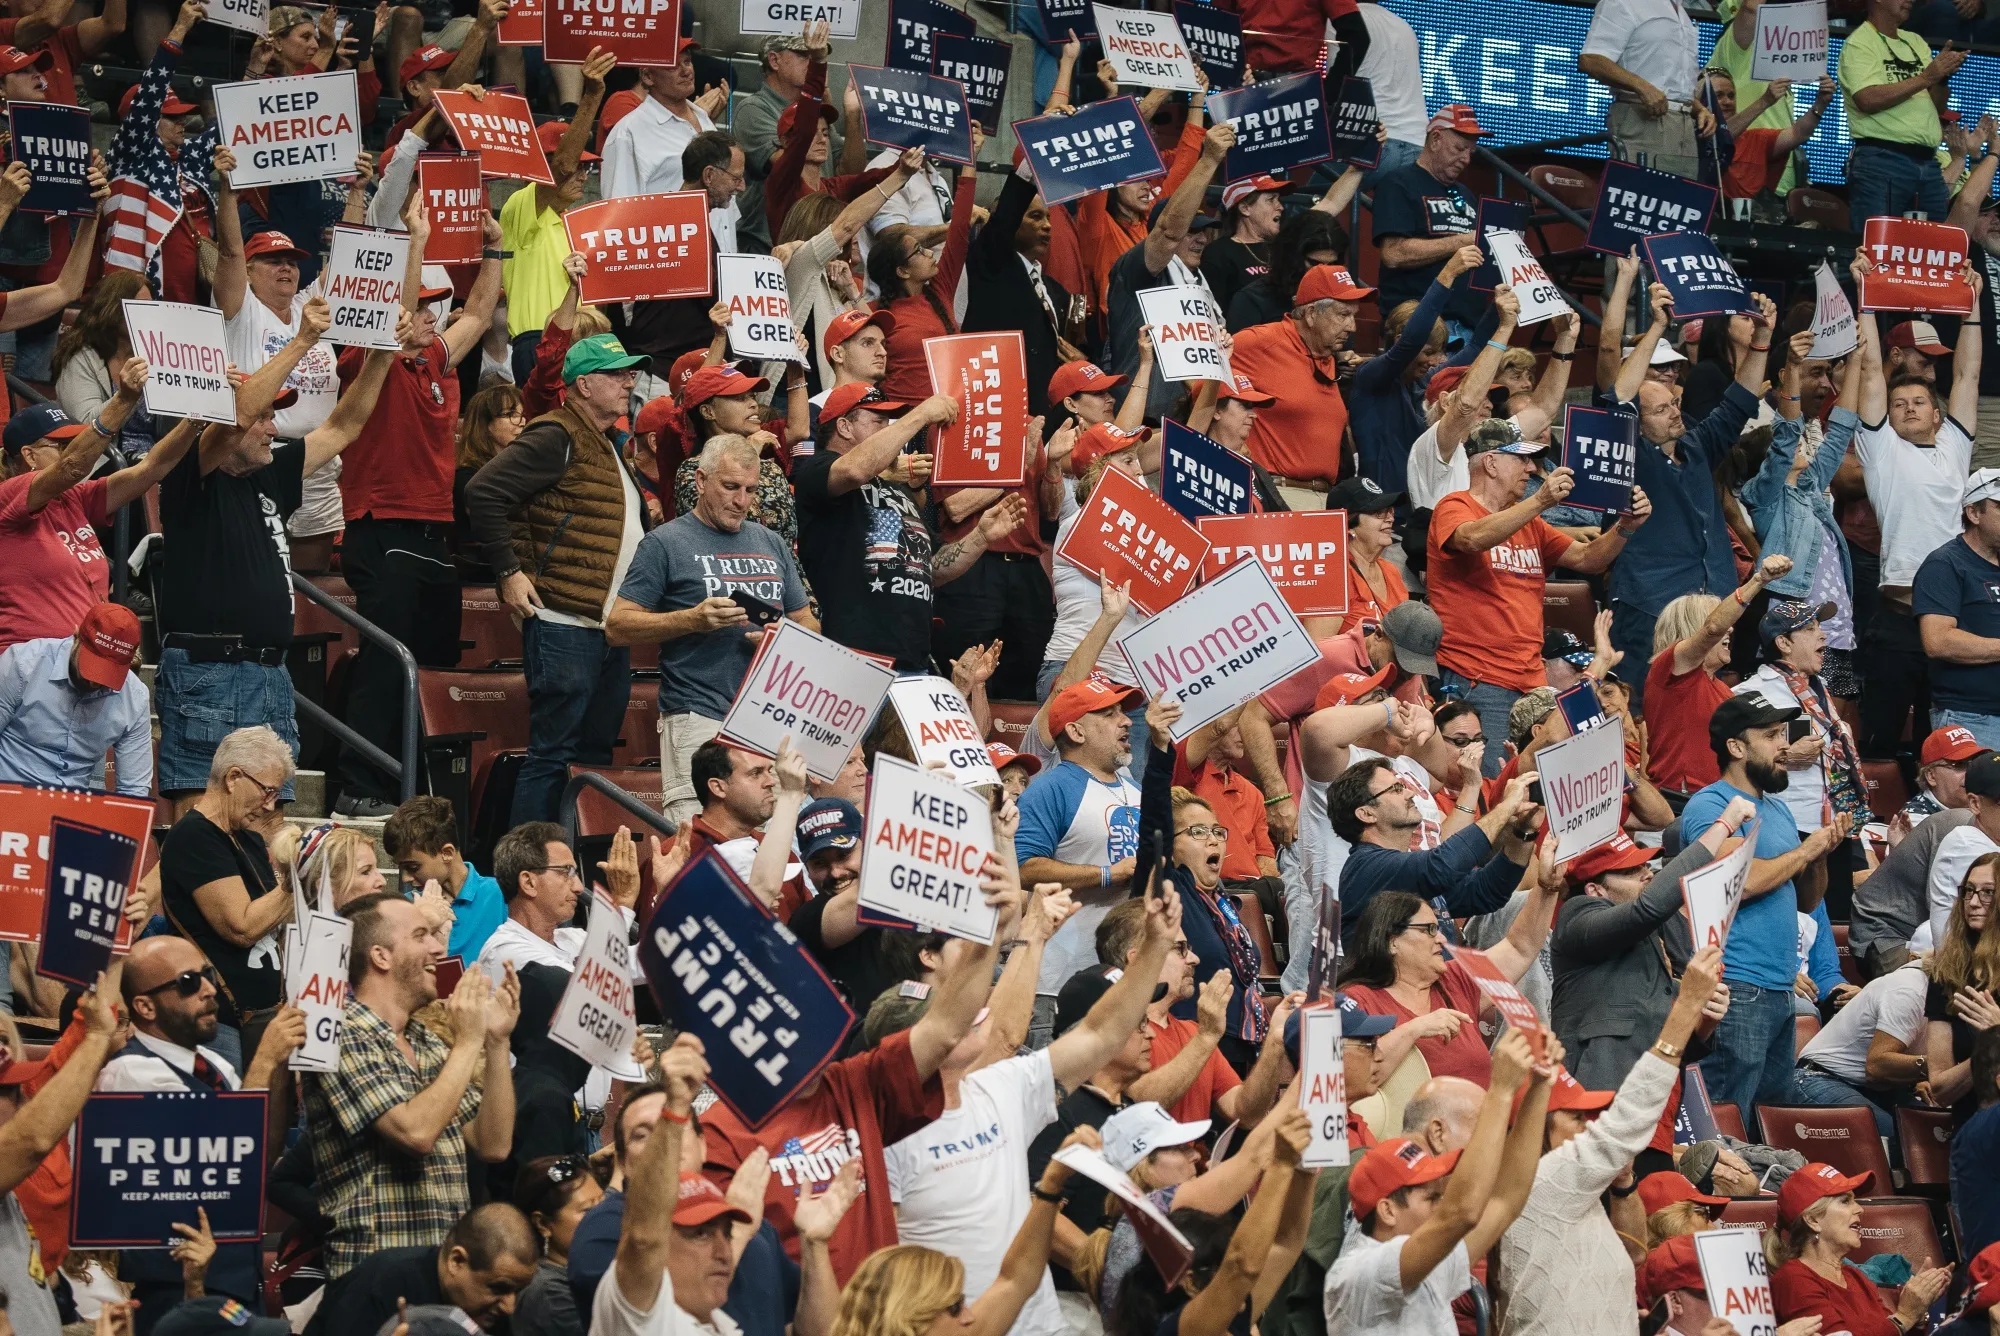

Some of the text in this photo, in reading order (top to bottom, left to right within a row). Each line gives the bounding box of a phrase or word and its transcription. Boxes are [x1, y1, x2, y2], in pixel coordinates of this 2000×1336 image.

[563, 15, 657, 30] PENCE
[767, 3, 842, 24] GREAT!
[588, 30, 620, 38] AMERICA
[622, 31, 648, 39] GREAT!
[1116, 19, 1156, 36] KEEP
[1182, 24, 1240, 49] TRUMP
[1108, 35, 1187, 60] AMERICA
[1190, 42, 1238, 61] PENCE
[1771, 53, 1799, 64] FOR
[940, 60, 1005, 86] TRUMP
[1126, 59, 1182, 78] GREAT!
[259, 91, 320, 115] KEEP
[864, 86, 961, 115] TRUMP
[963, 83, 999, 99] ENCE
[453, 112, 530, 136] TRUMP
[878, 102, 956, 128] PENCE
[888, 116, 950, 135] KEEP AMERICA GREAT!
[1226, 98, 1320, 133] TRUMP
[1335, 120, 1377, 134] PENCE
[231, 112, 354, 147] AMERICA
[470, 129, 531, 149] PENCE
[1031, 119, 1137, 157] TRUMP
[1237, 118, 1314, 147] PENCE
[21, 135, 89, 159] TRUMP
[480, 143, 493, 152] KEEP
[492, 145, 514, 155] AMERICA
[1049, 137, 1135, 168] PENCE
[1244, 134, 1309, 153] KEEP AMERICA GREAT!
[30, 158, 87, 176] PENCE
[253, 143, 338, 170] GREAT!
[1062, 152, 1132, 174] KEEP AMERICA GREAT!
[36, 175, 50, 183] KEEP
[50, 176, 69, 184] AMERICA
[1100, 182, 1115, 191] 2020
[429, 188, 481, 207] TRUMP
[1607, 187, 1702, 224] TRUMP
[437, 209, 480, 222] PENCE
[1610, 207, 1687, 231] PENCE
[580, 223, 698, 249] TRUMP
[1614, 221, 1653, 235] KEEP AMERICA
[354, 248, 393, 272] KEEP
[596, 245, 690, 263] PENCE
[604, 260, 681, 272] KEEP AMERICA GREAT!
[1872, 244, 1962, 268] TRUMP
[1677, 272, 1745, 288] PENCE
[1879, 264, 1954, 281] PENCE
[1903, 279, 1927, 287] AMERICA
[329, 274, 401, 304] AMERICA
[1689, 284, 1729, 292] KEEP AMERICA
[335, 306, 389, 331] GREAT!
[1821, 326, 1837, 339] FOR
[137, 329, 226, 374] Women
[157, 371, 221, 393] FOR TRUMP
[681, 368, 692, 382] 45
[961, 367, 970, 388] KEEP
[964, 387, 972, 425] AMERICA
[968, 357, 984, 460] PENCE
[982, 344, 1003, 472] TRUMP
[1576, 436, 1635, 461] TRUM
[1169, 447, 1245, 501] TRUMP
[1589, 474, 1623, 485] KEEP AMERICA
[1176, 472, 1238, 515] PENCE
[1181, 489, 1216, 512] KEEP AMERICA
[1101, 497, 1191, 572] TRUMP
[1099, 521, 1174, 584] PENCE
[1103, 540, 1162, 588] KEEP AMERICA GREAT!
[695, 554, 778, 577] TRUMP
[1492, 563, 1530, 573] KEEP AMERICA
[702, 576, 784, 600] PENCE
[890, 576, 931, 600] 2020
[1292, 579, 1318, 588] GREAT!
[94, 639, 115, 650] GREAT
[96, 632, 112, 641] MAKE
[1142, 601, 1282, 692] Women
[1176, 635, 1279, 702] FOR TRUMP
[763, 653, 866, 734] Women
[1239, 691, 1256, 703] 2020
[762, 703, 842, 749] FOR TRUMP
[1550, 759, 1619, 817] Women
[911, 790, 968, 830] KEEP
[1566, 799, 1613, 834] FOR TRUMP
[799, 811, 844, 835] TRUMP
[814, 828, 832, 838] 2020
[876, 818, 997, 881] AMERICA
[890, 864, 972, 913] GREAT!
[604, 931, 629, 970] KEEP
[679, 915, 799, 1048] PENCE
[654, 926, 789, 1086] TRUMP
[578, 1003, 627, 1053] GREAT!
[94, 1136, 255, 1164] TRUMP
[929, 1123, 1000, 1159] TRUMP
[1133, 1139, 1147, 1154] 45
[769, 1127, 860, 1187] TRUMP
[109, 1168, 242, 1186] PENCE
[122, 1191, 231, 1201] KEEP AMERICA GREAT!
